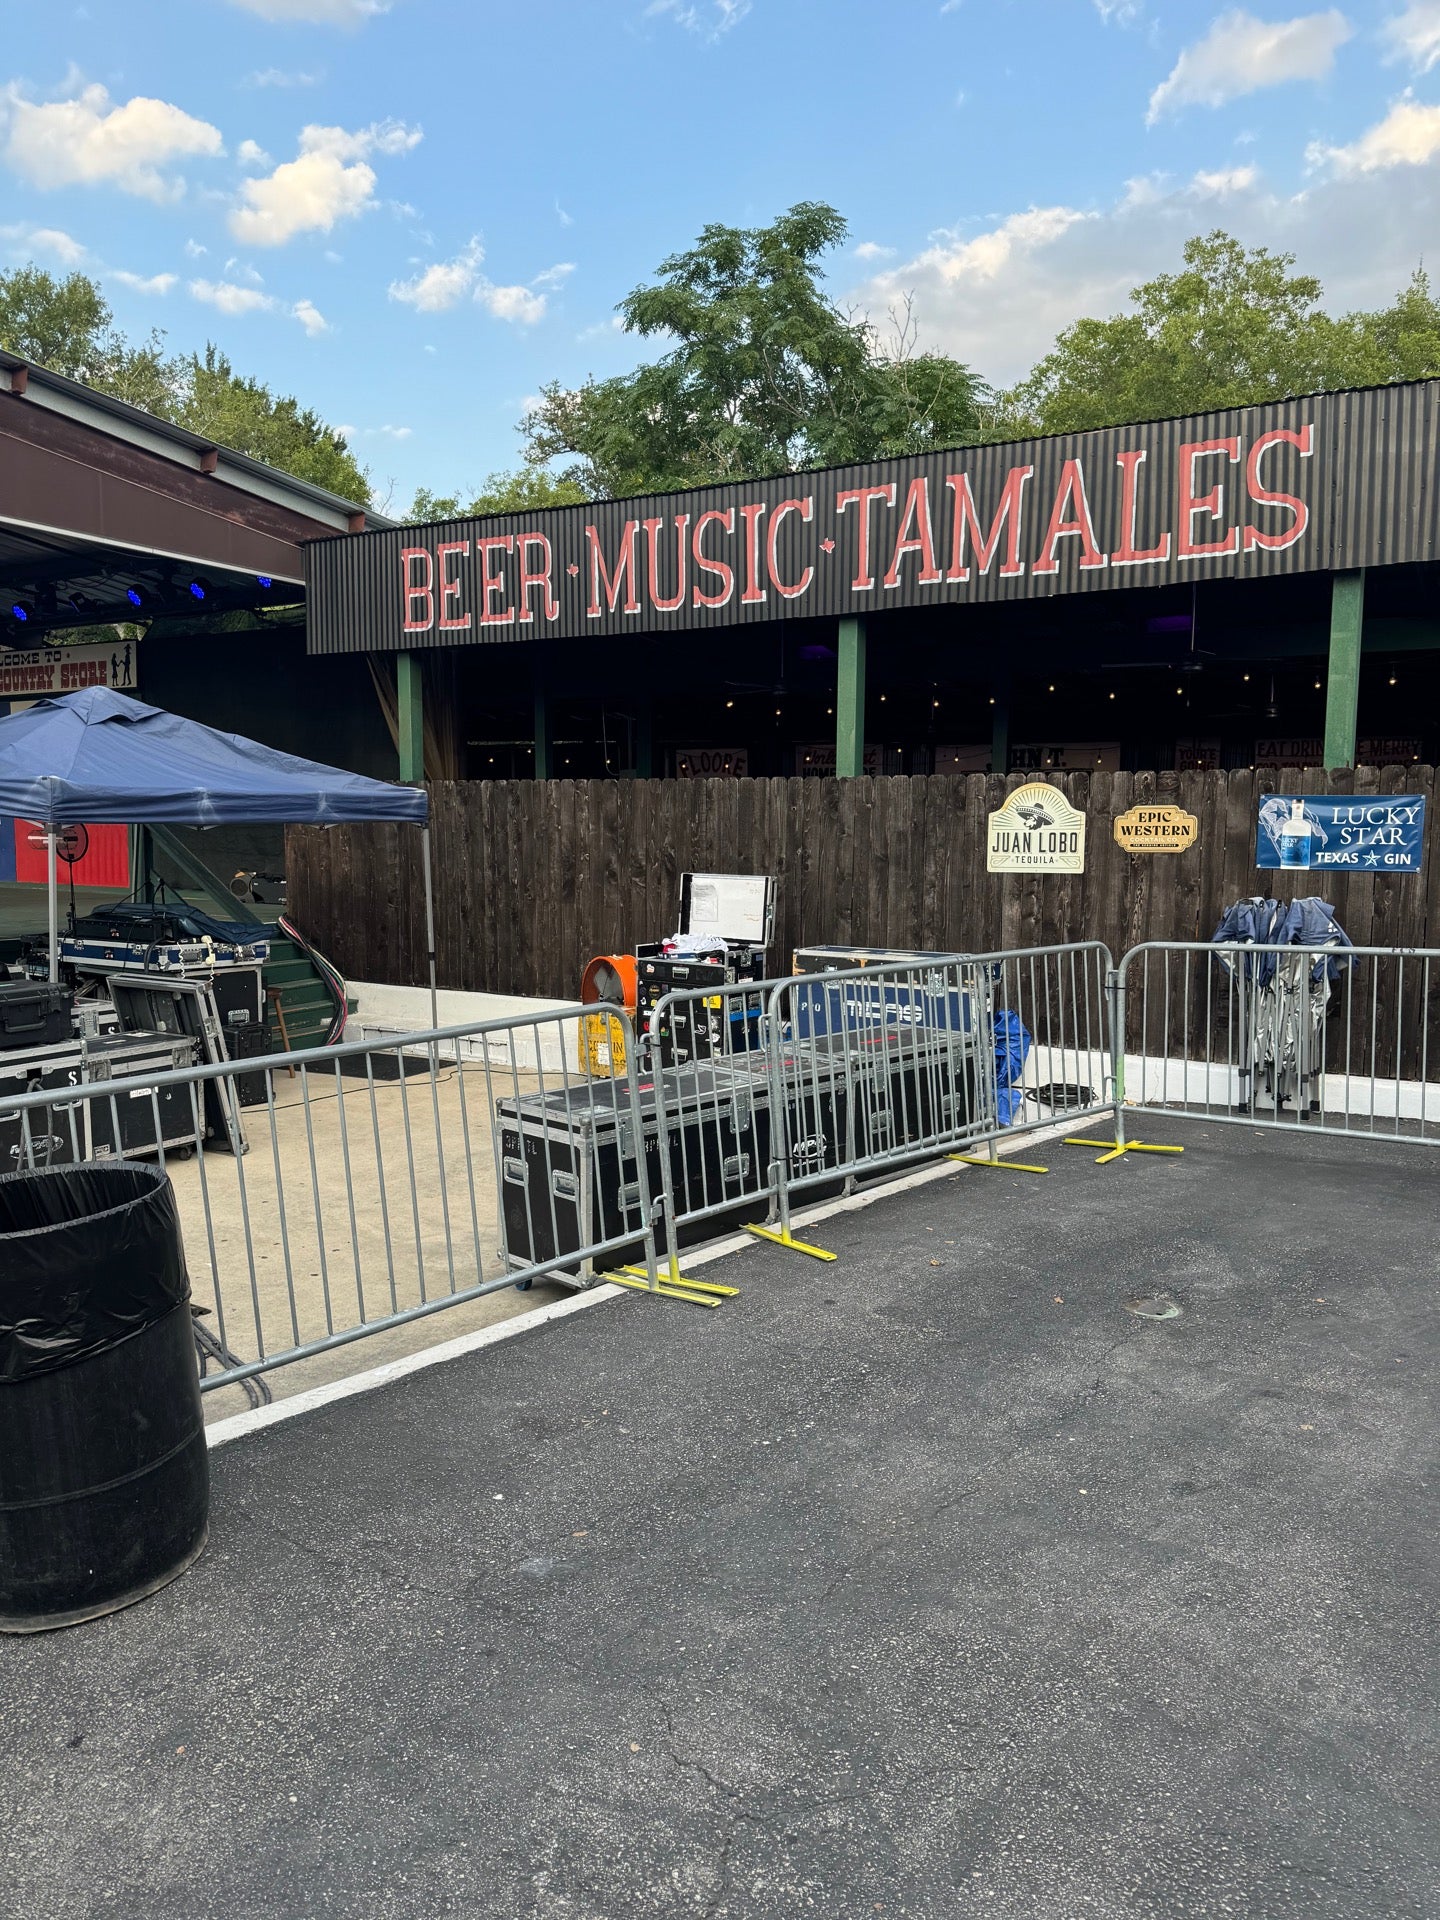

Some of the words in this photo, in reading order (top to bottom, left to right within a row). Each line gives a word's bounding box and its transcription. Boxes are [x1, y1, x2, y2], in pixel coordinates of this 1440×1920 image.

[401, 532, 559, 632] BEER
[586, 496, 814, 618] MUSIC
[836, 424, 1313, 591] TAMALES
[44, 650, 62, 662] TO
[60, 661, 108, 688] STORE
[1138, 812, 1172, 823] EPIC
[1331, 807, 1421, 825] LUCKY
[1120, 825, 1190, 836] WESTERN
[1340, 827, 1408, 846] STAR
[992, 832, 1031, 853] JUAN
[1039, 832, 1078, 853] LOBO
[1014, 856, 1055, 864] TEQUILA
[1315, 852, 1359, 864] TEXAS
[1384, 853, 1411, 865] GIN
